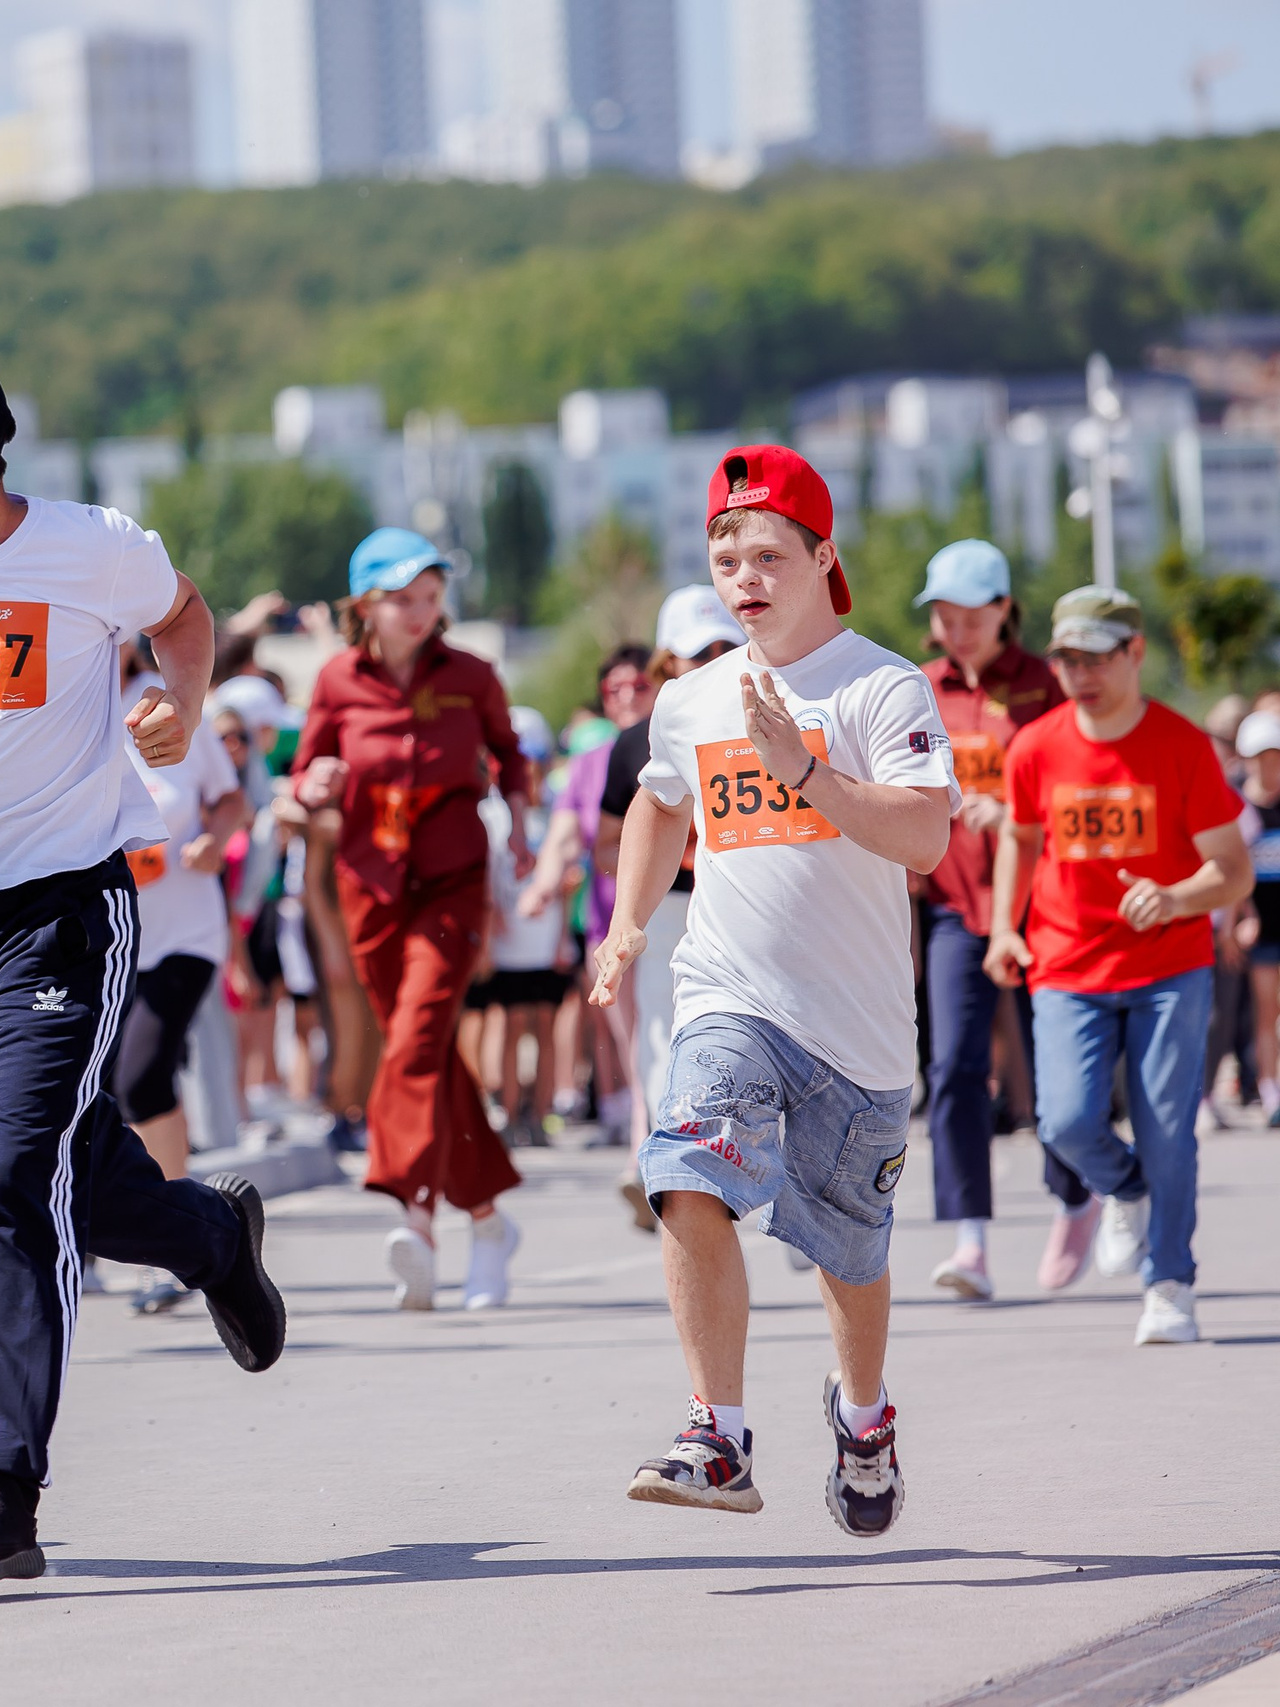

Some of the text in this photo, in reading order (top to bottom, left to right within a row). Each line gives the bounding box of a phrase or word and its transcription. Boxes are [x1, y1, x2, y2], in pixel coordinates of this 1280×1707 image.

[734, 747, 754, 757] СБЕР
[1063, 806, 1145, 838] 3531
[32, 1003, 65, 1012] adidas
